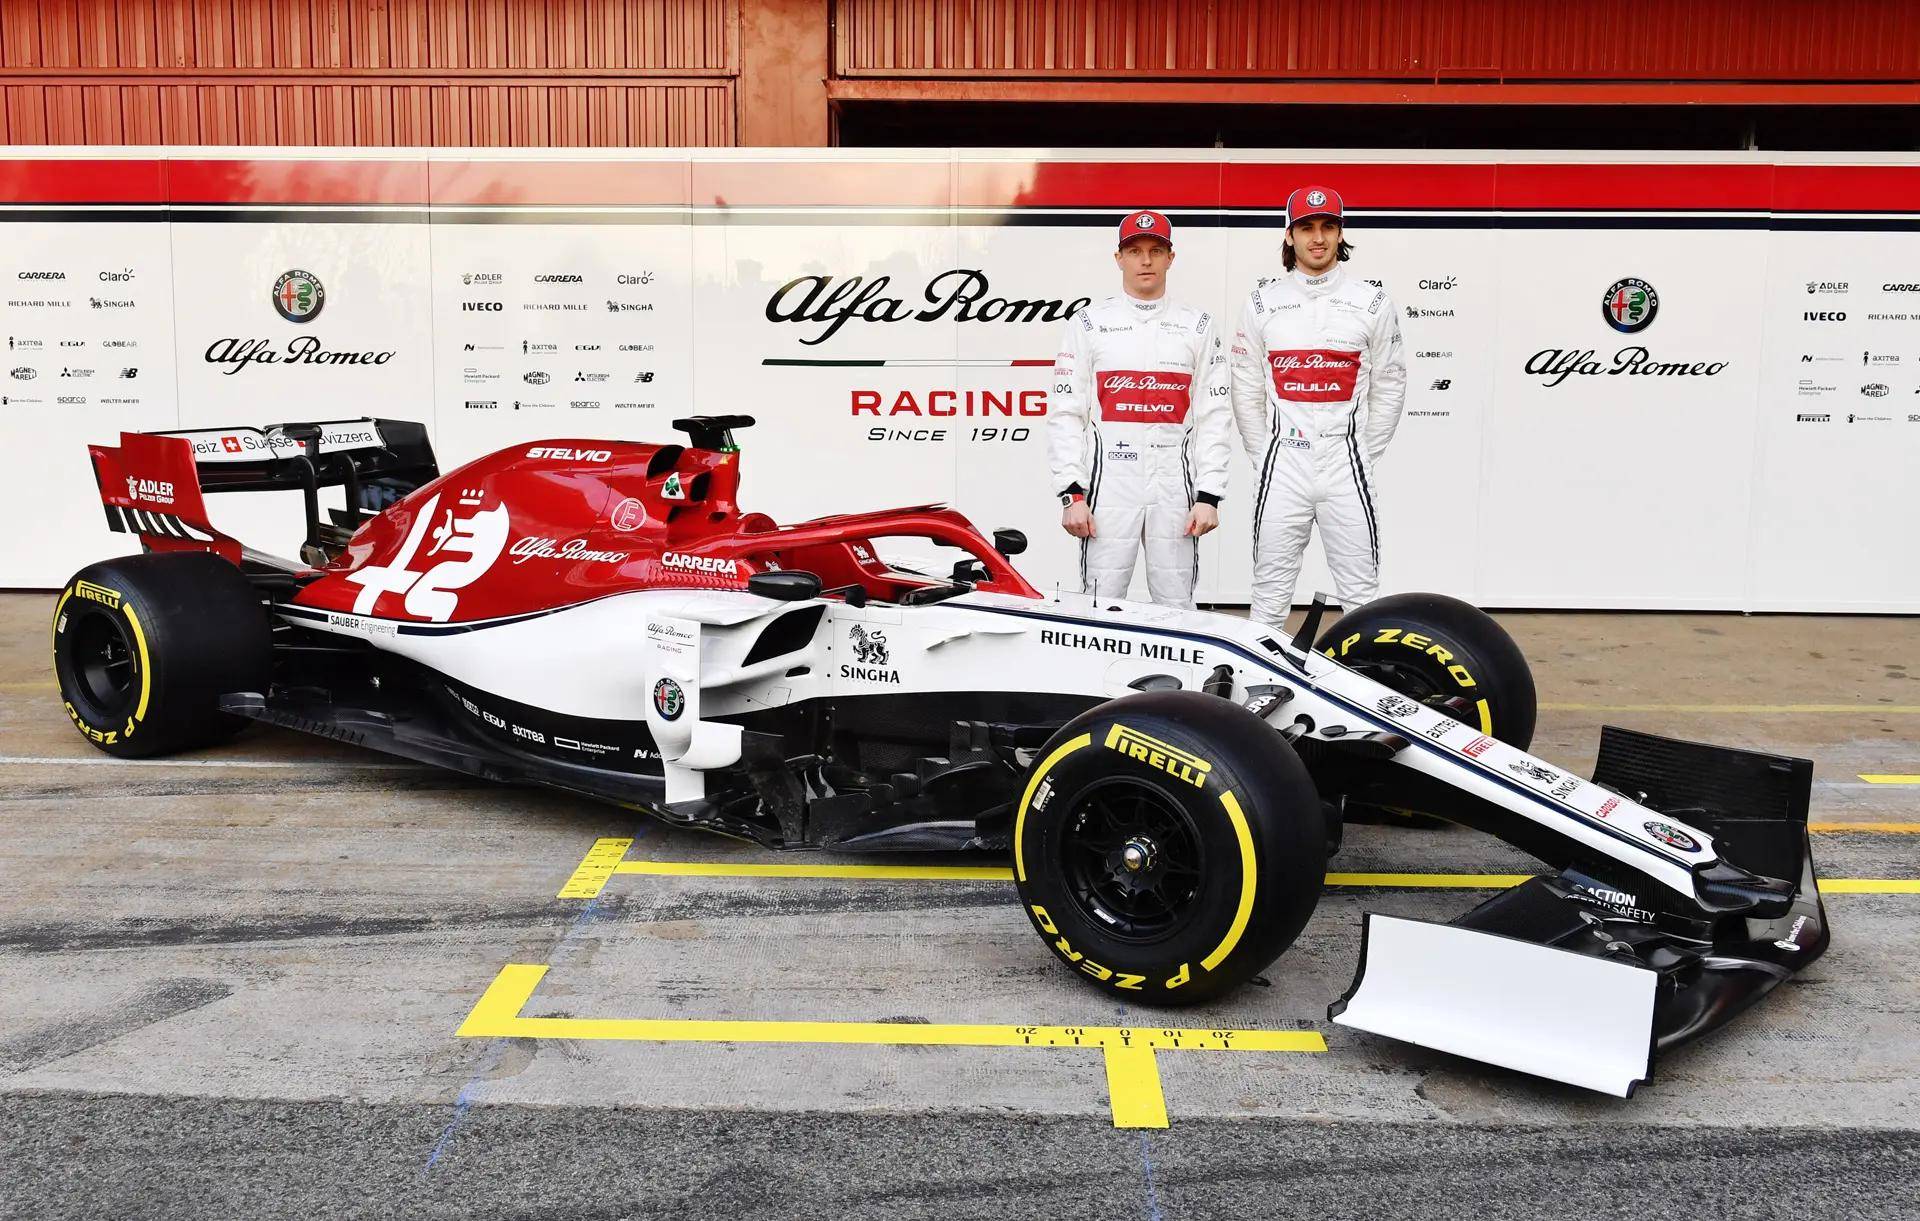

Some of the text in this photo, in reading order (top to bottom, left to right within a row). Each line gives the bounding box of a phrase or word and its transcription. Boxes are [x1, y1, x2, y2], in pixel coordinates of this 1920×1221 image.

[99, 271, 131, 281] Claro
[274, 271, 323, 298] ALFA ROMEO
[534, 275, 583, 283] CARRERA
[617, 274, 649, 284] Claro
[1419, 279, 1451, 290] Claro
[1603, 279, 1657, 307] ALFA ROMEO
[1819, 282, 1849, 290] ADLER
[103, 300, 136, 308] SINGHA
[462, 302, 503, 311] IVECO
[620, 303, 654, 311] SINGHA
[765, 269, 1092, 345] Alfa Rome
[1420, 309, 1455, 317] SINGHA
[1804, 311, 1847, 321] IVECO
[204, 335, 397, 375] Alfa Romeo
[618, 344, 655, 352] GLOBEAIR
[1274, 354, 1353, 373] Alfa Romeo
[1524, 346, 1730, 387] Alfa Romeo
[1104, 376, 1187, 394] Alfa Romeo
[1283, 382, 1342, 392] GIULIA
[57, 396, 87, 404] sparco
[465, 401, 497, 409] PIRELLI
[570, 401, 600, 409] sparco
[851, 390, 1048, 416] RACING
[1116, 402, 1175, 412] STELVIO
[1796, 414, 1830, 422] PIRELLI
[970, 428, 1031, 442] 1910
[526, 447, 612, 463] STELVIO
[139, 479, 173, 497] ADLER
[509, 536, 630, 565] Alfa Romeo
[661, 552, 738, 574] CARRERA
[75, 579, 122, 609] PIRELLI
[330, 615, 396, 638] SAUBER Engineering
[648, 622, 694, 639] Alfa Romeo
[1041, 630, 1205, 665] RICHARD MILLE
[1341, 628, 1477, 688] P ZERO
[840, 664, 900, 684] SINGHA
[65, 701, 135, 745] ZERO P
[1426, 719, 1459, 738] axitea
[512, 724, 545, 743] axitea
[1461, 735, 1498, 758] PIRELLI
[1104, 723, 1212, 789] PIRELLI
[1588, 887, 1636, 907] ACTION
[1612, 904, 1656, 921] SAFETY
[1030, 904, 1190, 990] P ZERO
[1016, 1027, 1234, 1039] 20 10 0 10 20
